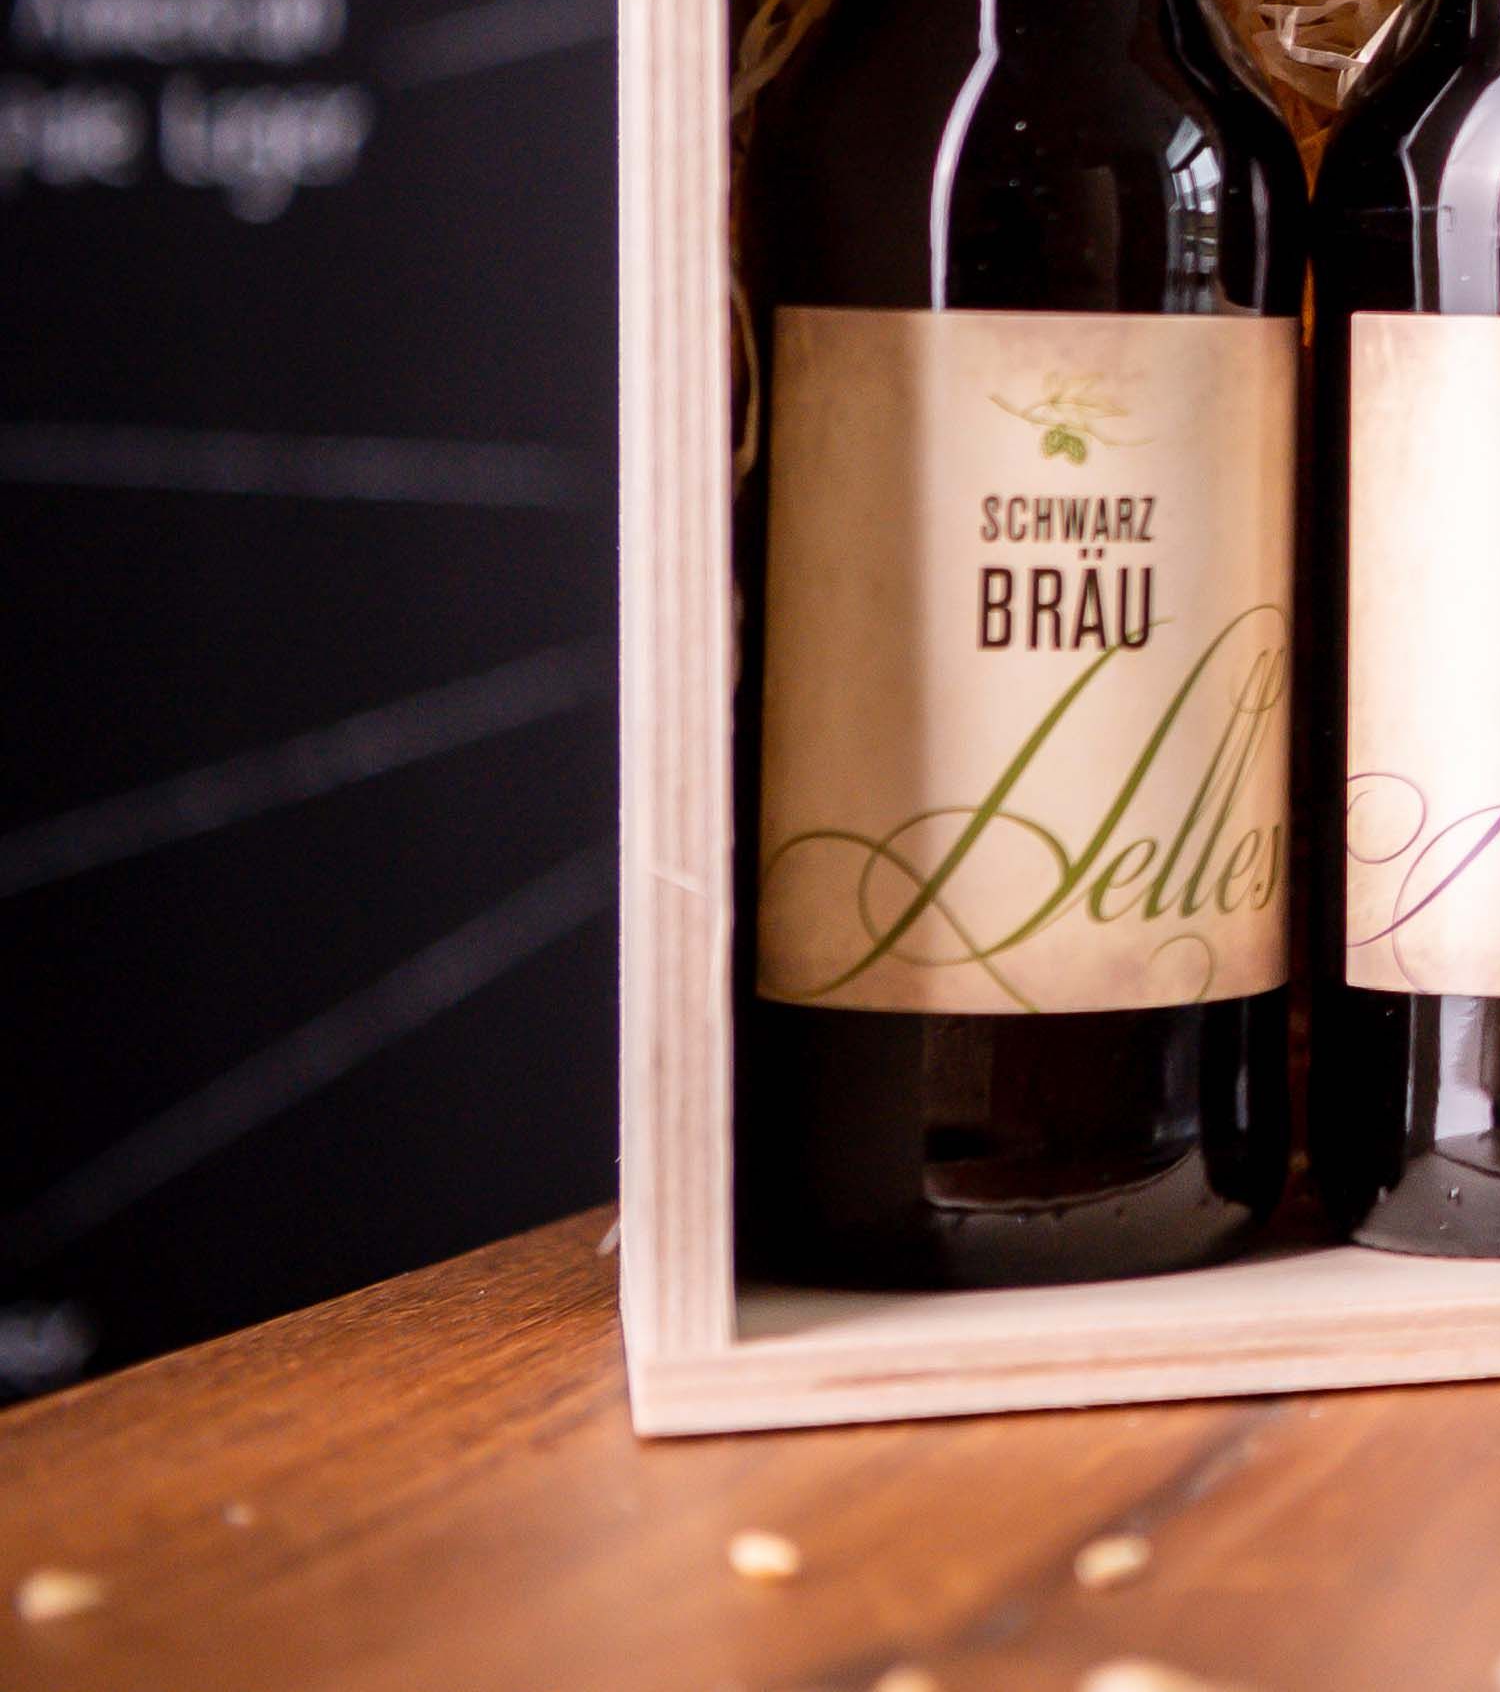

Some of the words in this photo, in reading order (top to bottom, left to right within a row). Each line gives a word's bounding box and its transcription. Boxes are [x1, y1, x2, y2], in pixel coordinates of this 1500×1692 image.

[980, 496, 1156, 543] SCHWARZ
[977, 548, 1154, 652] BRÄU
[762, 603, 1288, 1014] Helles
